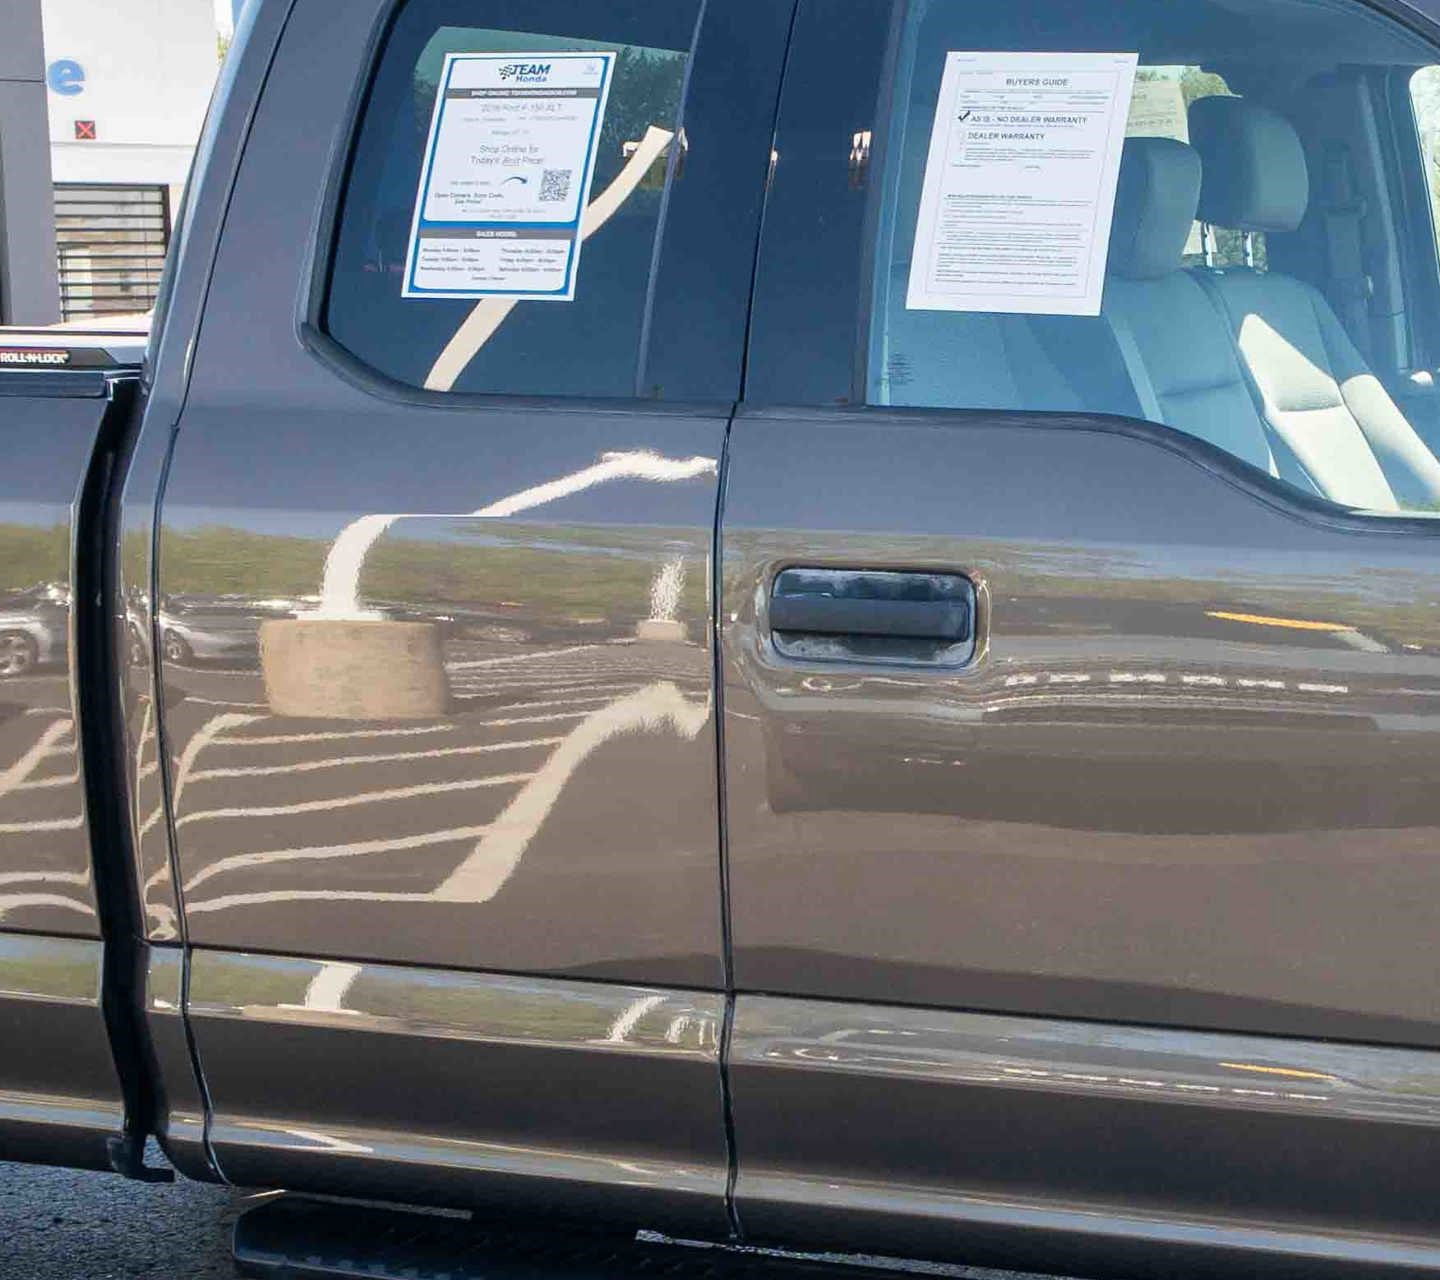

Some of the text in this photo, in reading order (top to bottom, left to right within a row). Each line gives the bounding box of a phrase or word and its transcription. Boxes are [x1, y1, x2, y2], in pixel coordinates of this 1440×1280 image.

[511, 64, 551, 75] TEAM
[1006, 78, 1068, 87] BUYERS GUIDE
[1010, 116, 1041, 124] DEALER
[1043, 116, 1087, 125] WARRANTY
[968, 132, 1045, 141] DEALER WARRANTY
